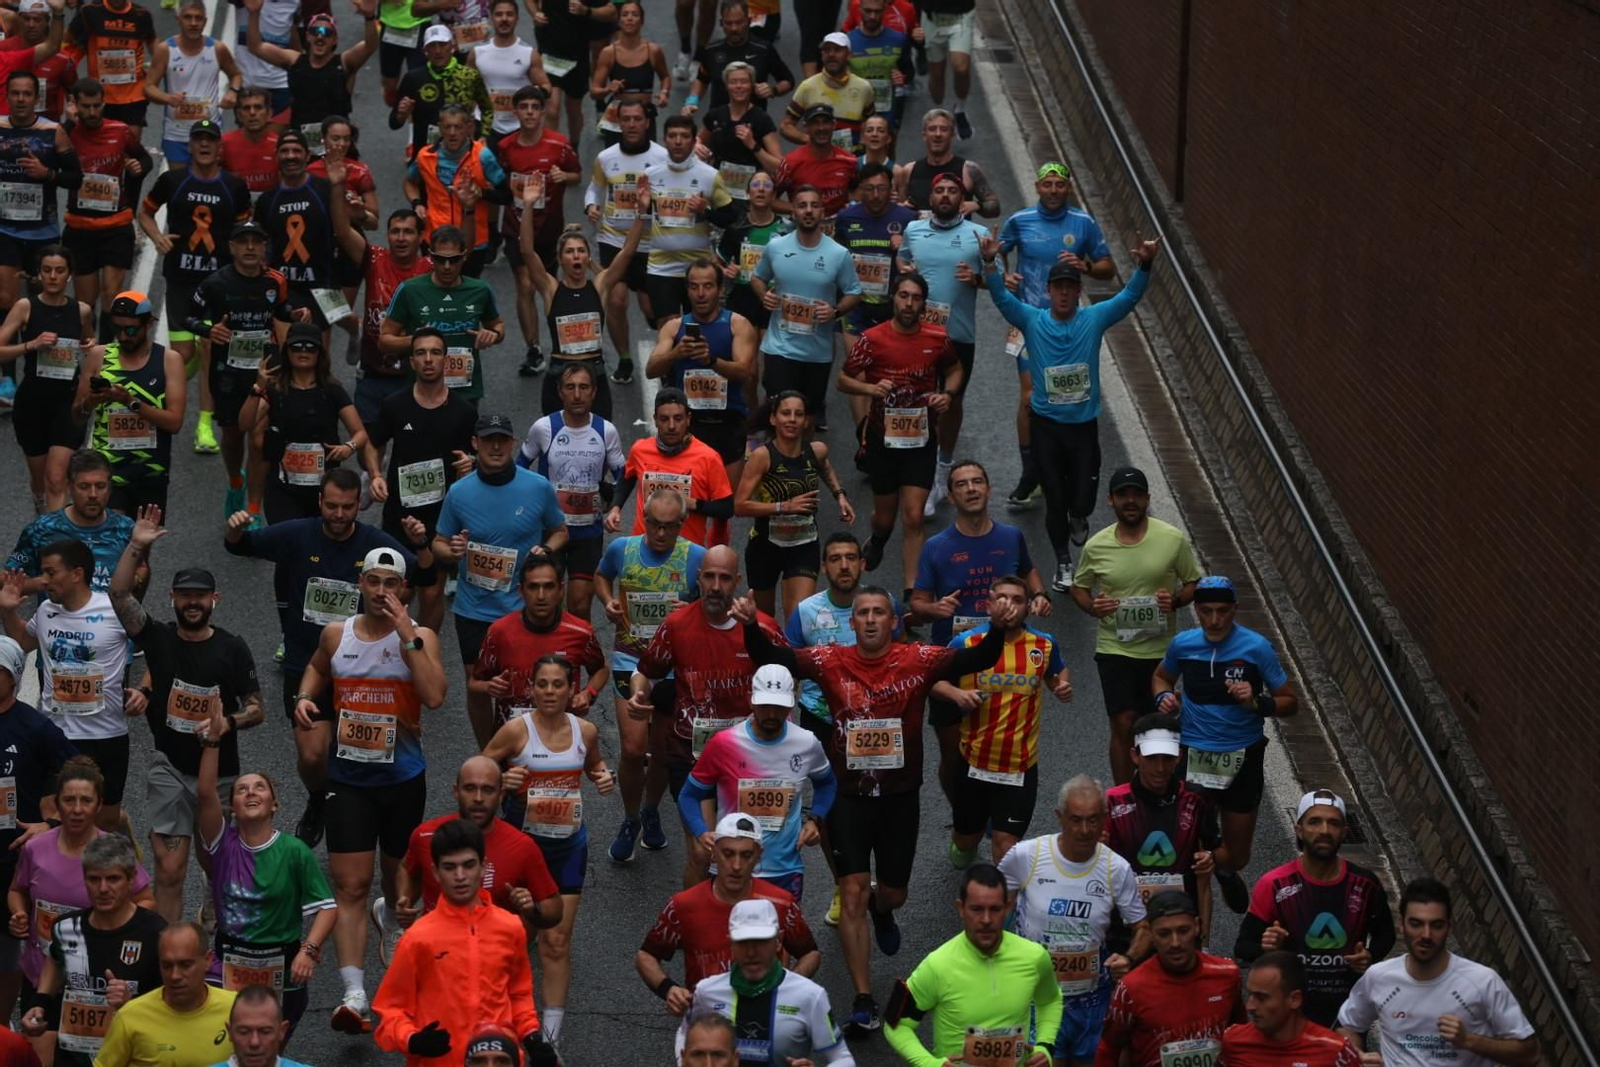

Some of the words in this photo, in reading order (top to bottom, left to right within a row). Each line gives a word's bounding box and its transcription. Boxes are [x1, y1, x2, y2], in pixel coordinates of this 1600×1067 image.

[84, 183, 110, 195] 5440
[4, 193, 35, 203] 17394
[187, 192, 220, 203] STOP
[618, 194, 636, 203] 449
[279, 202, 310, 213] STOP
[662, 200, 686, 211] 4497
[180, 254, 217, 270] ELA
[743, 251, 762, 264] 120
[856, 264, 880, 276] 4576
[785, 304, 809, 318] 4321
[237, 339, 263, 352] 7454
[691, 379, 717, 392] 6142
[1053, 375, 1080, 387] 6663
[115, 418, 144, 430] 5826
[892, 419, 919, 430] 5074
[406, 472, 434, 488] 7319
[473, 555, 503, 571] 5254
[970, 566, 993, 575] RUN
[314, 590, 346, 606] 8027
[635, 603, 666, 618] 7628
[1122, 608, 1154, 622] 7169
[48, 630, 94, 639] MADRID
[1225, 668, 1244, 678] CN
[60, 680, 91, 694] 4579
[175, 695, 208, 713] 5628
[347, 724, 381, 741] 3807
[855, 732, 890, 748] 5229
[1197, 752, 1230, 768] 7479
[747, 791, 784, 807] 3599
[1068, 901, 1090, 917] IVI
[70, 1008, 106, 1027] 5187
[973, 1041, 1011, 1057] 5982
